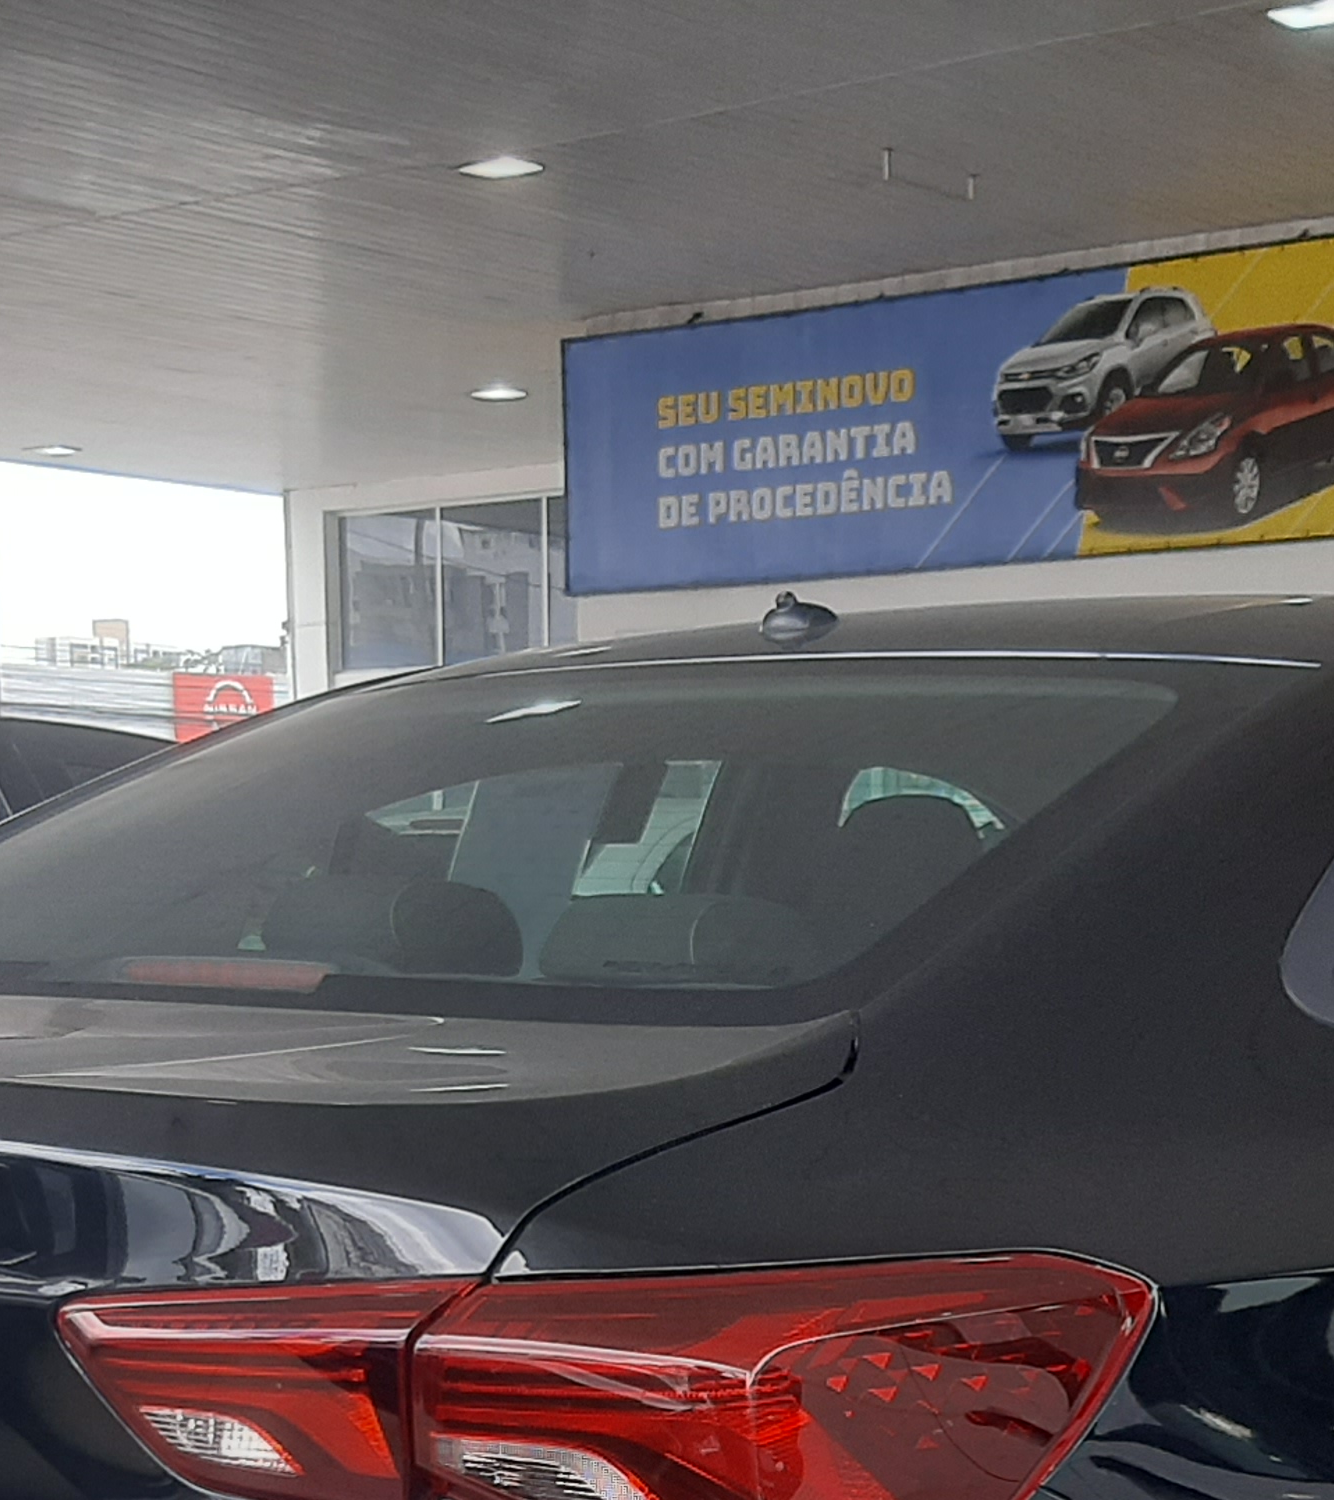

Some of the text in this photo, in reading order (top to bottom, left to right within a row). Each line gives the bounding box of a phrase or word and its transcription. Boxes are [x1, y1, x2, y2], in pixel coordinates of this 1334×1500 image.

[658, 368, 915, 429] SEU SEMINOVO
[658, 421, 916, 478] COM GARANTIA
[658, 468, 954, 529] DE PROCEDÊNCIA
